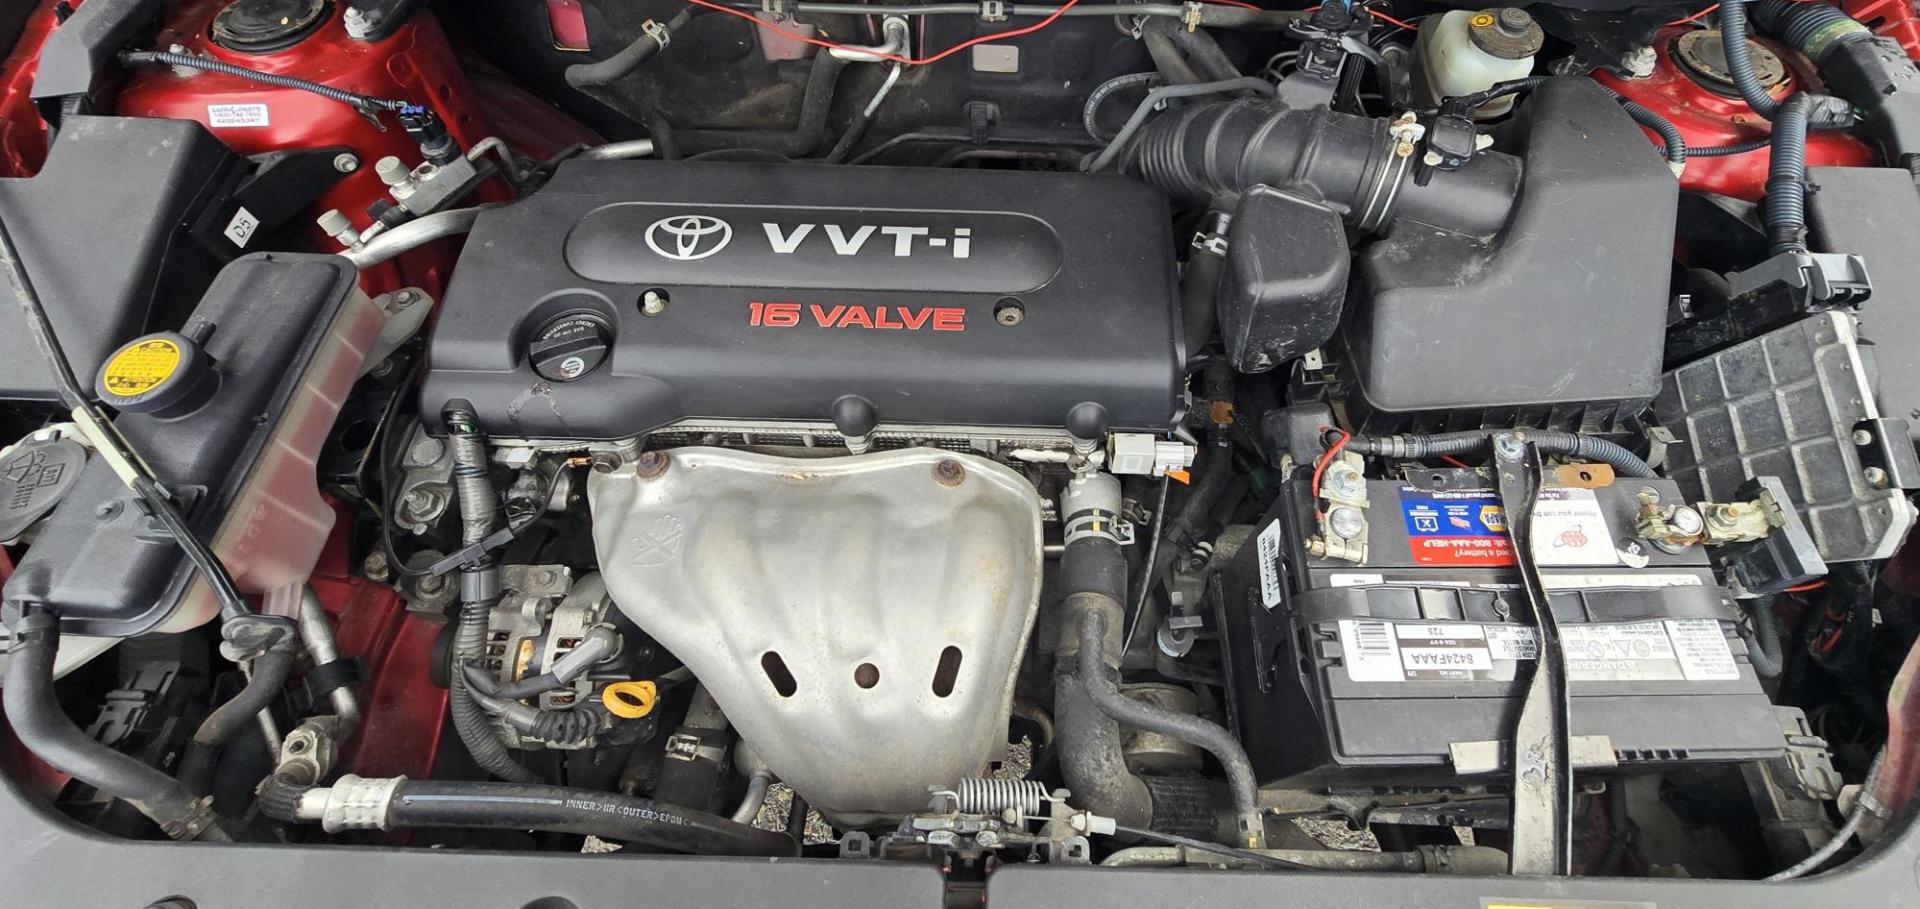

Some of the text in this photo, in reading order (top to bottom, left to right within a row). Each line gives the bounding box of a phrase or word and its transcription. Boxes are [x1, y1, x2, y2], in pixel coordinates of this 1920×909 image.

[762, 222, 971, 258] VVT-i
[749, 302, 967, 332] 16 VALVE
[1423, 539, 1492, 547] 800-AAA-HELP
[1411, 653, 1474, 665] 8424FAAA
